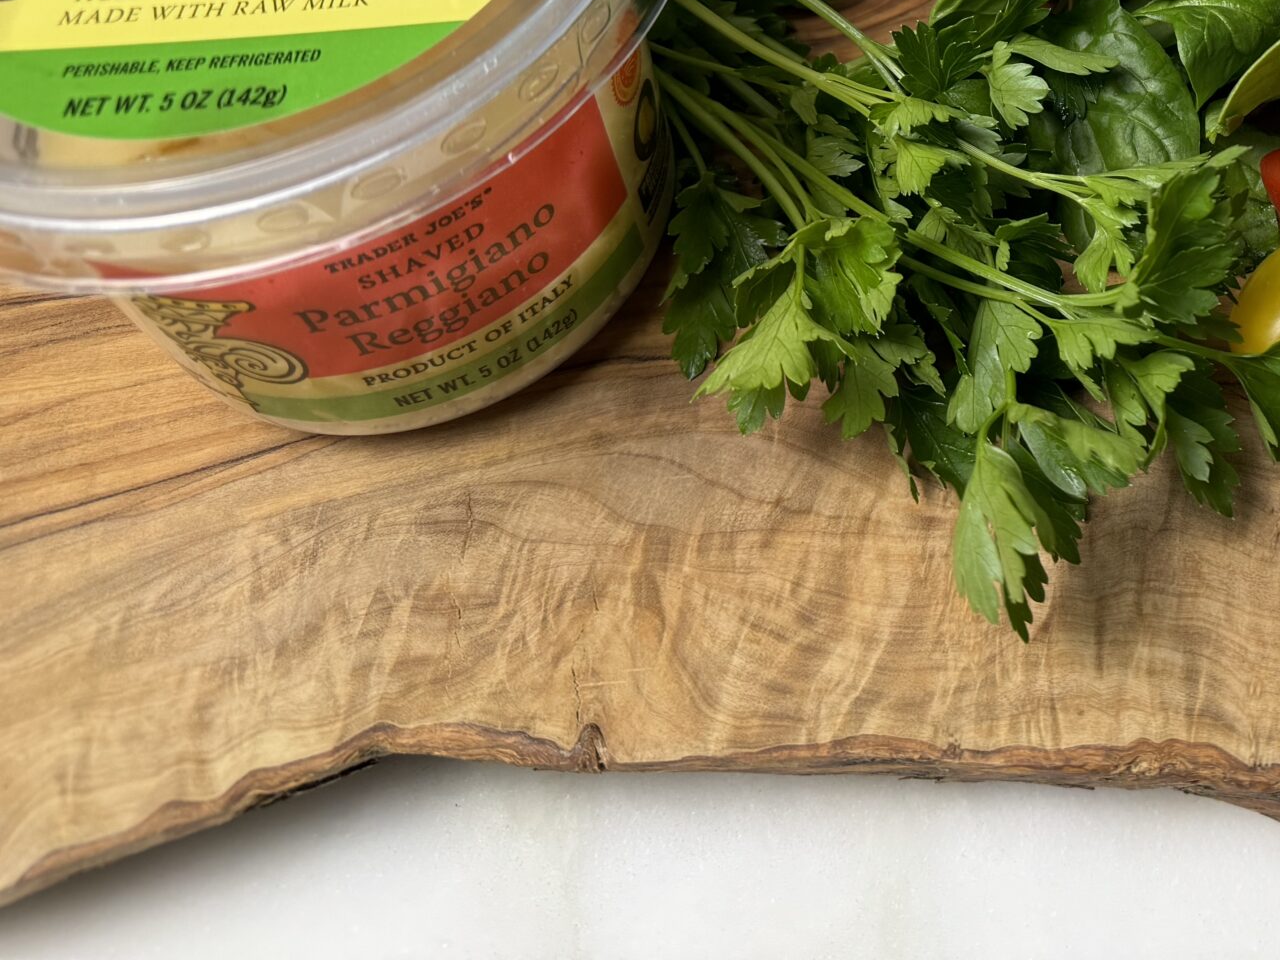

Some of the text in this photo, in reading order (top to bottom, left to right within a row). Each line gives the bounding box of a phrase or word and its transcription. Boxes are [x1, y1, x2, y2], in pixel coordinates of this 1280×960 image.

[57, 7, 142, 27] MADE
[151, 1, 226, 22] WITH
[62, 48, 322, 79] PERISHABLE, KEEP REFRIGERATED
[63, 84, 288, 118] NET WT. 5 OZ (142g)
[293, 203, 556, 333] Parmigiano
[324, 232, 417, 274] TRADER
[357, 222, 485, 290] SHAVED
[345, 251, 549, 357] Reggiano
[362, 274, 575, 386] PRODUCT OF ITALY
[392, 308, 579, 408] NET WT. 5 OZ (142g)
